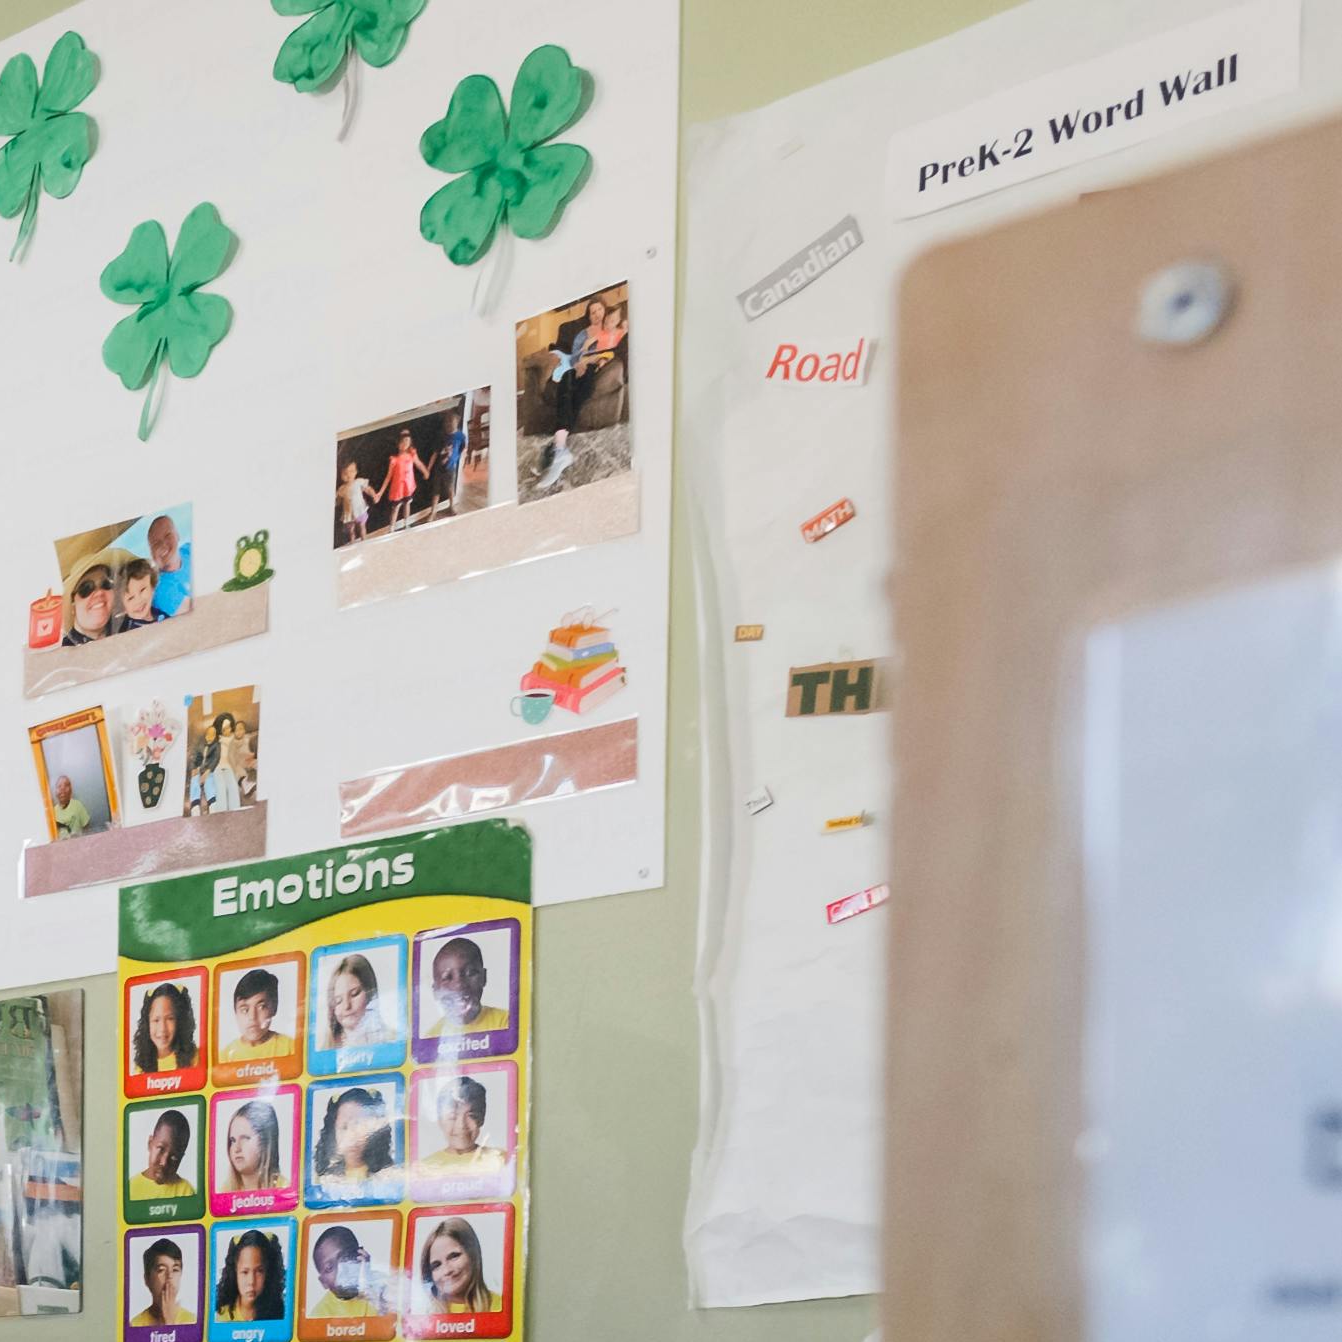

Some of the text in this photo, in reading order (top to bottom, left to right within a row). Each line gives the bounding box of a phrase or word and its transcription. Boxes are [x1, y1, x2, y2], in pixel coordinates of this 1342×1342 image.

[917, 54, 1241, 192] PreK-2 Word Wall
[742, 228, 860, 319] Canadian
[765, 337, 865, 383] Road
[737, 625, 763, 640] DAY
[213, 851, 416, 918] Emotions
[236, 1062, 275, 1079] afraid
[146, 1075, 182, 1091] happy
[149, 1203, 177, 1217] sorry
[230, 1194, 275, 1212] jealous
[326, 1322, 366, 1337] bored
[436, 1318, 475, 1333] loved
[150, 1330, 175, 1342] tired
[232, 1327, 265, 1342] angry
